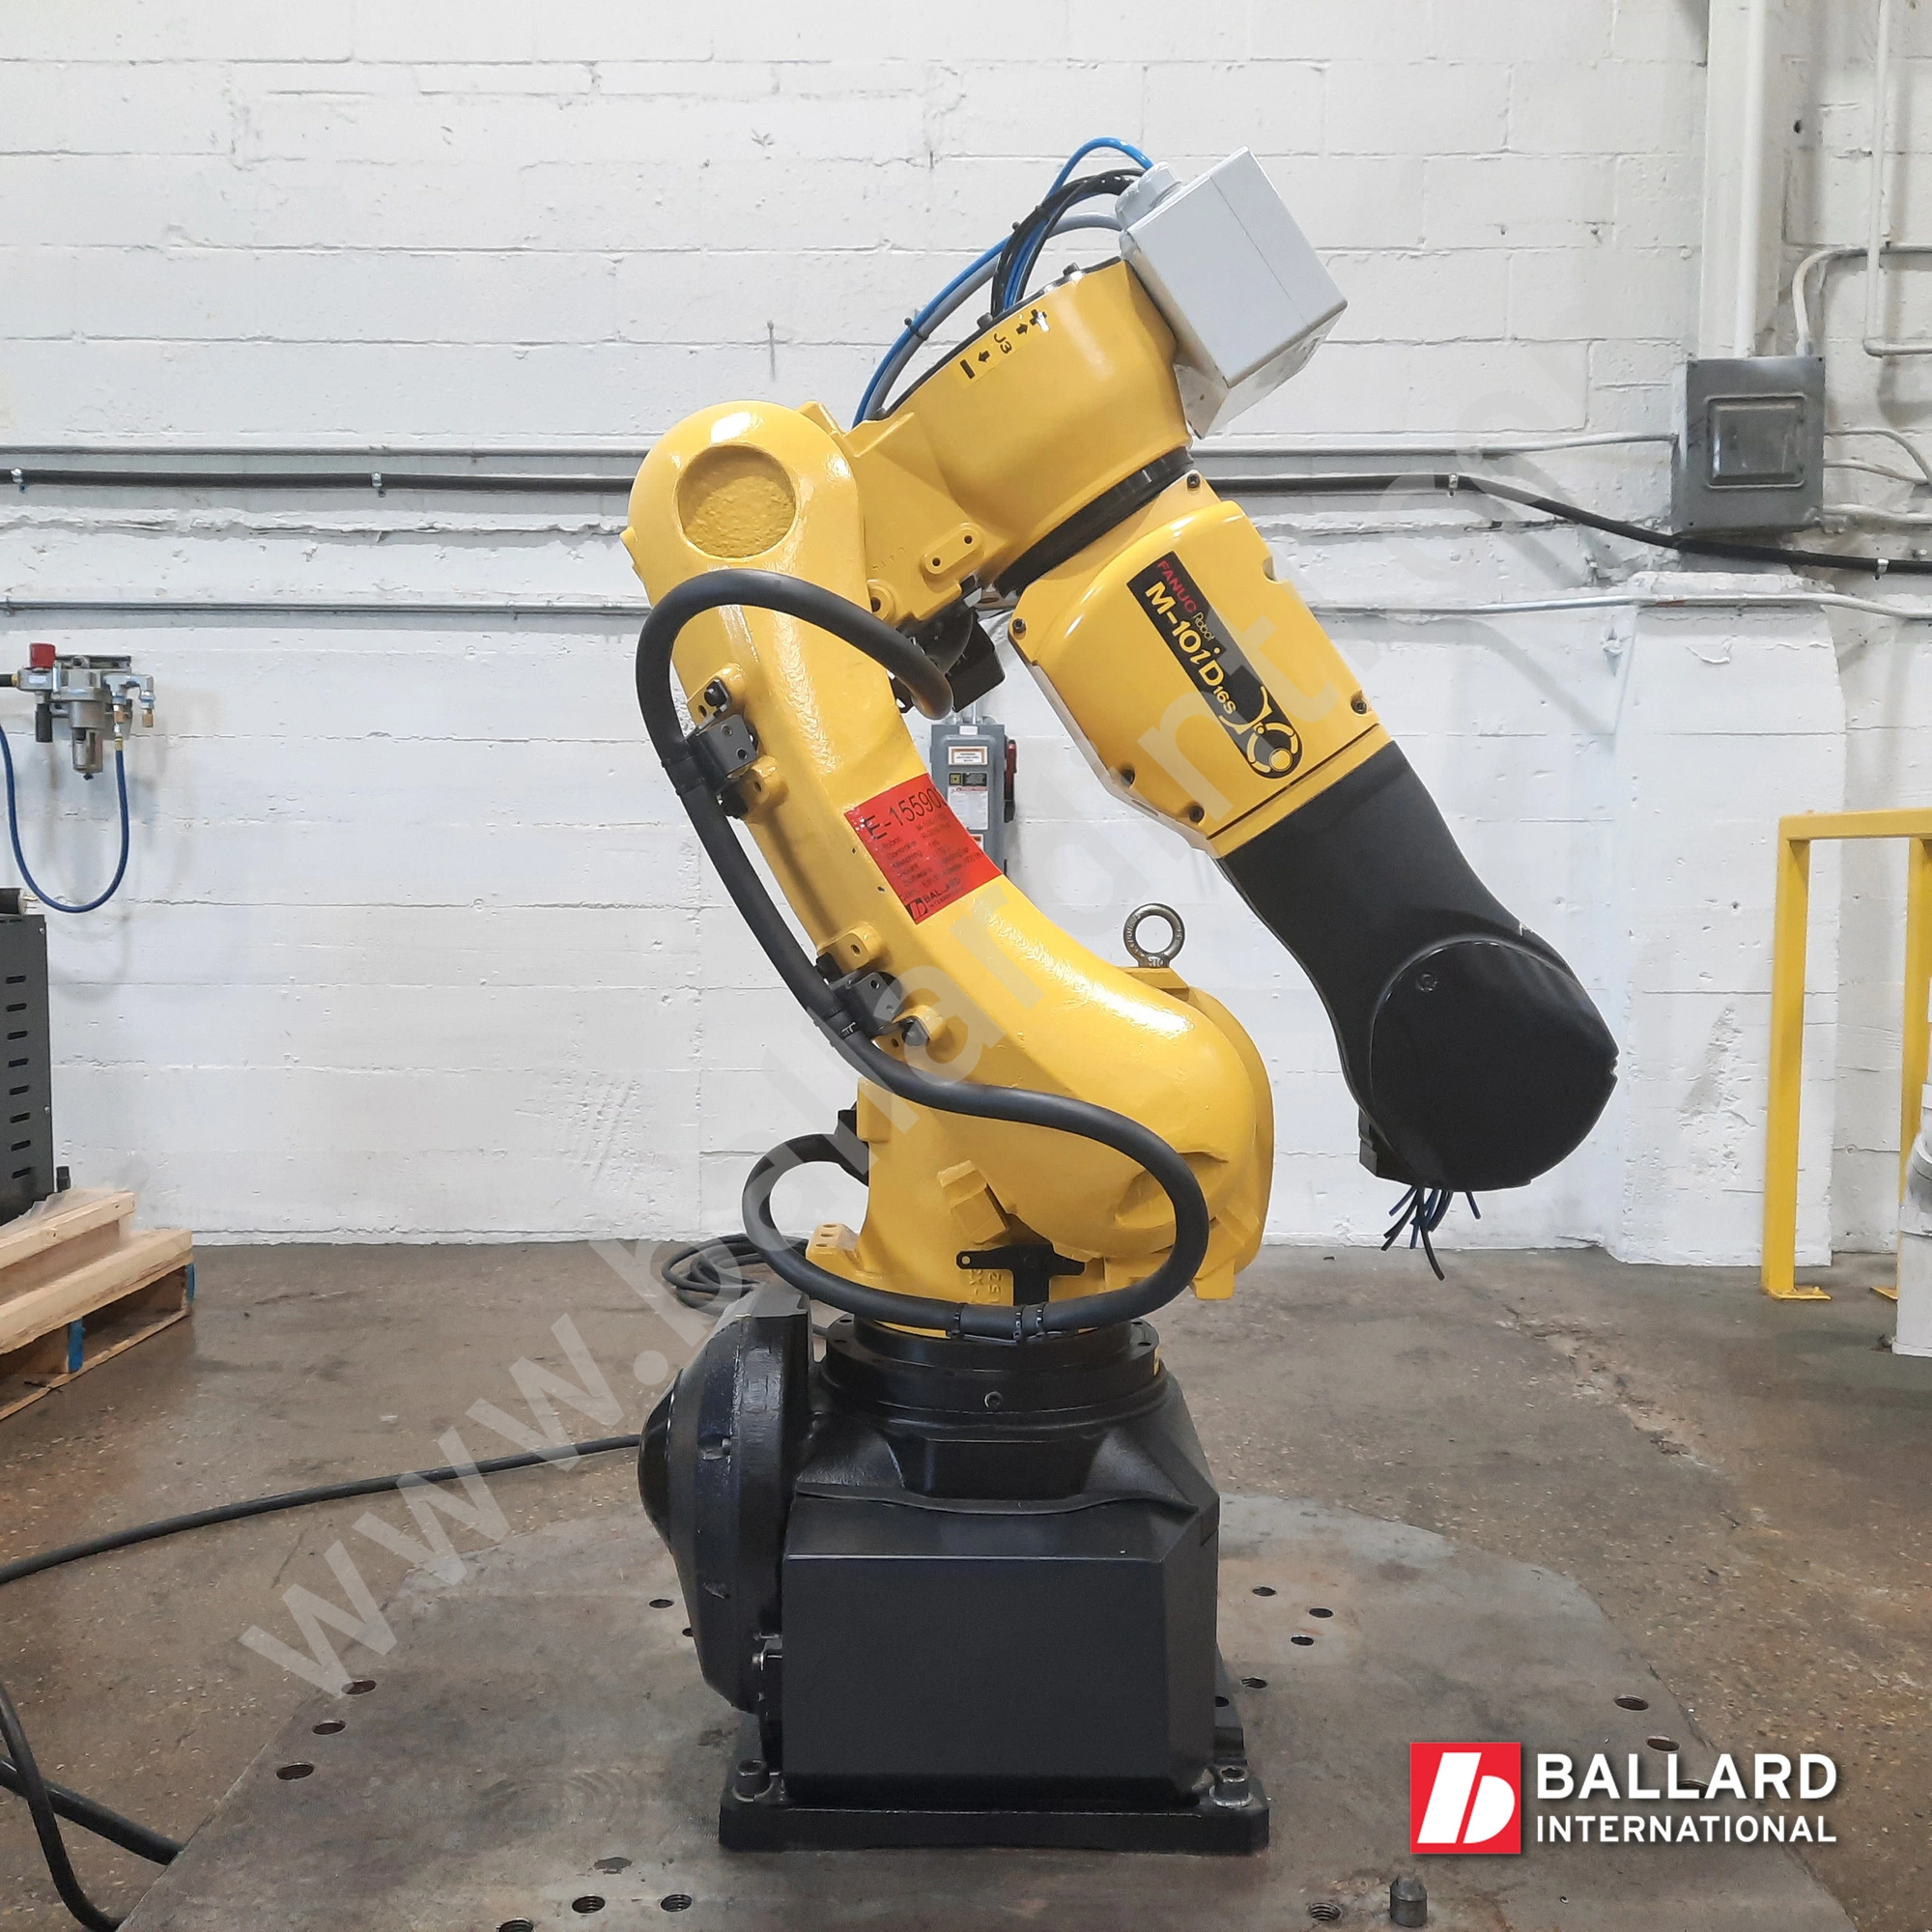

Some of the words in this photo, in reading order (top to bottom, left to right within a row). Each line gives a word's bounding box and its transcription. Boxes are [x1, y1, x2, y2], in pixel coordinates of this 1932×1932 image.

[993, 332, 1012, 355] J3
[1156, 560, 1198, 613] FANUC
[1192, 611, 1215, 641] Robot
